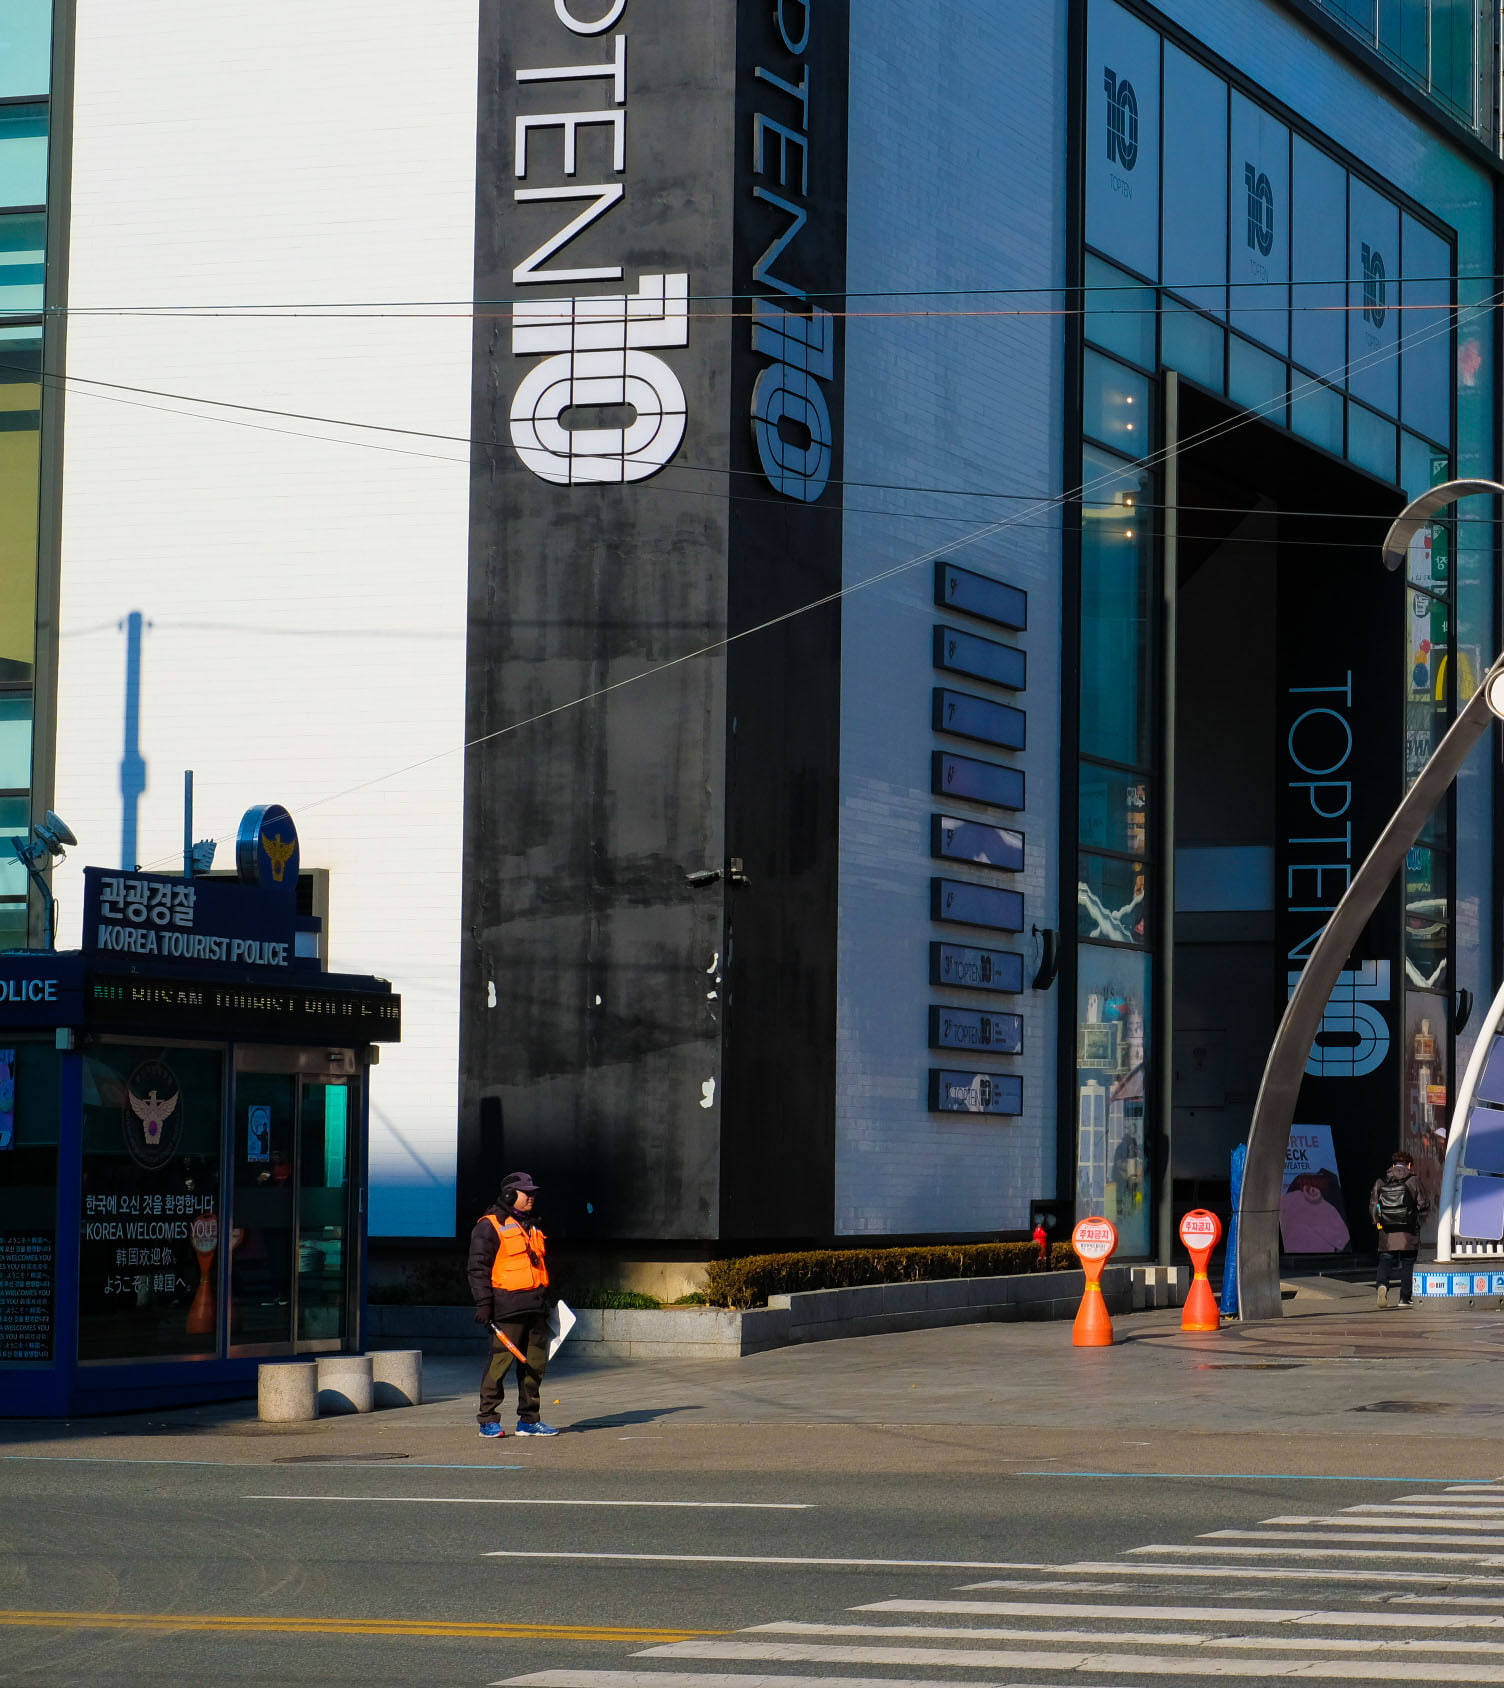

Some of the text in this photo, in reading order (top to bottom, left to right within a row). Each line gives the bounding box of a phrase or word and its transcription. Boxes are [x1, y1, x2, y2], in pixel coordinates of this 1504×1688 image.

[1104, 65, 1139, 172] 10
[1244, 160, 1274, 257] 10
[1361, 241, 1386, 329] 10
[99, 877, 196, 927] 관광경찰
[98, 925, 288, 966] KOREA TOURIST POLICE
[1290, 1136, 1319, 1148] RTLE
[1286, 1149, 1308, 1160] ECK
[1285, 1161, 1311, 1169] EATER
[86, 1194, 214, 1215] 한국에 오신 것을 환영합니다
[86, 1222, 212, 1240] KOREA WELCOMES YOU
[1080, 1229, 1109, 1240] 주차금지
[1186, 1222, 1211, 1231] 주차금지
